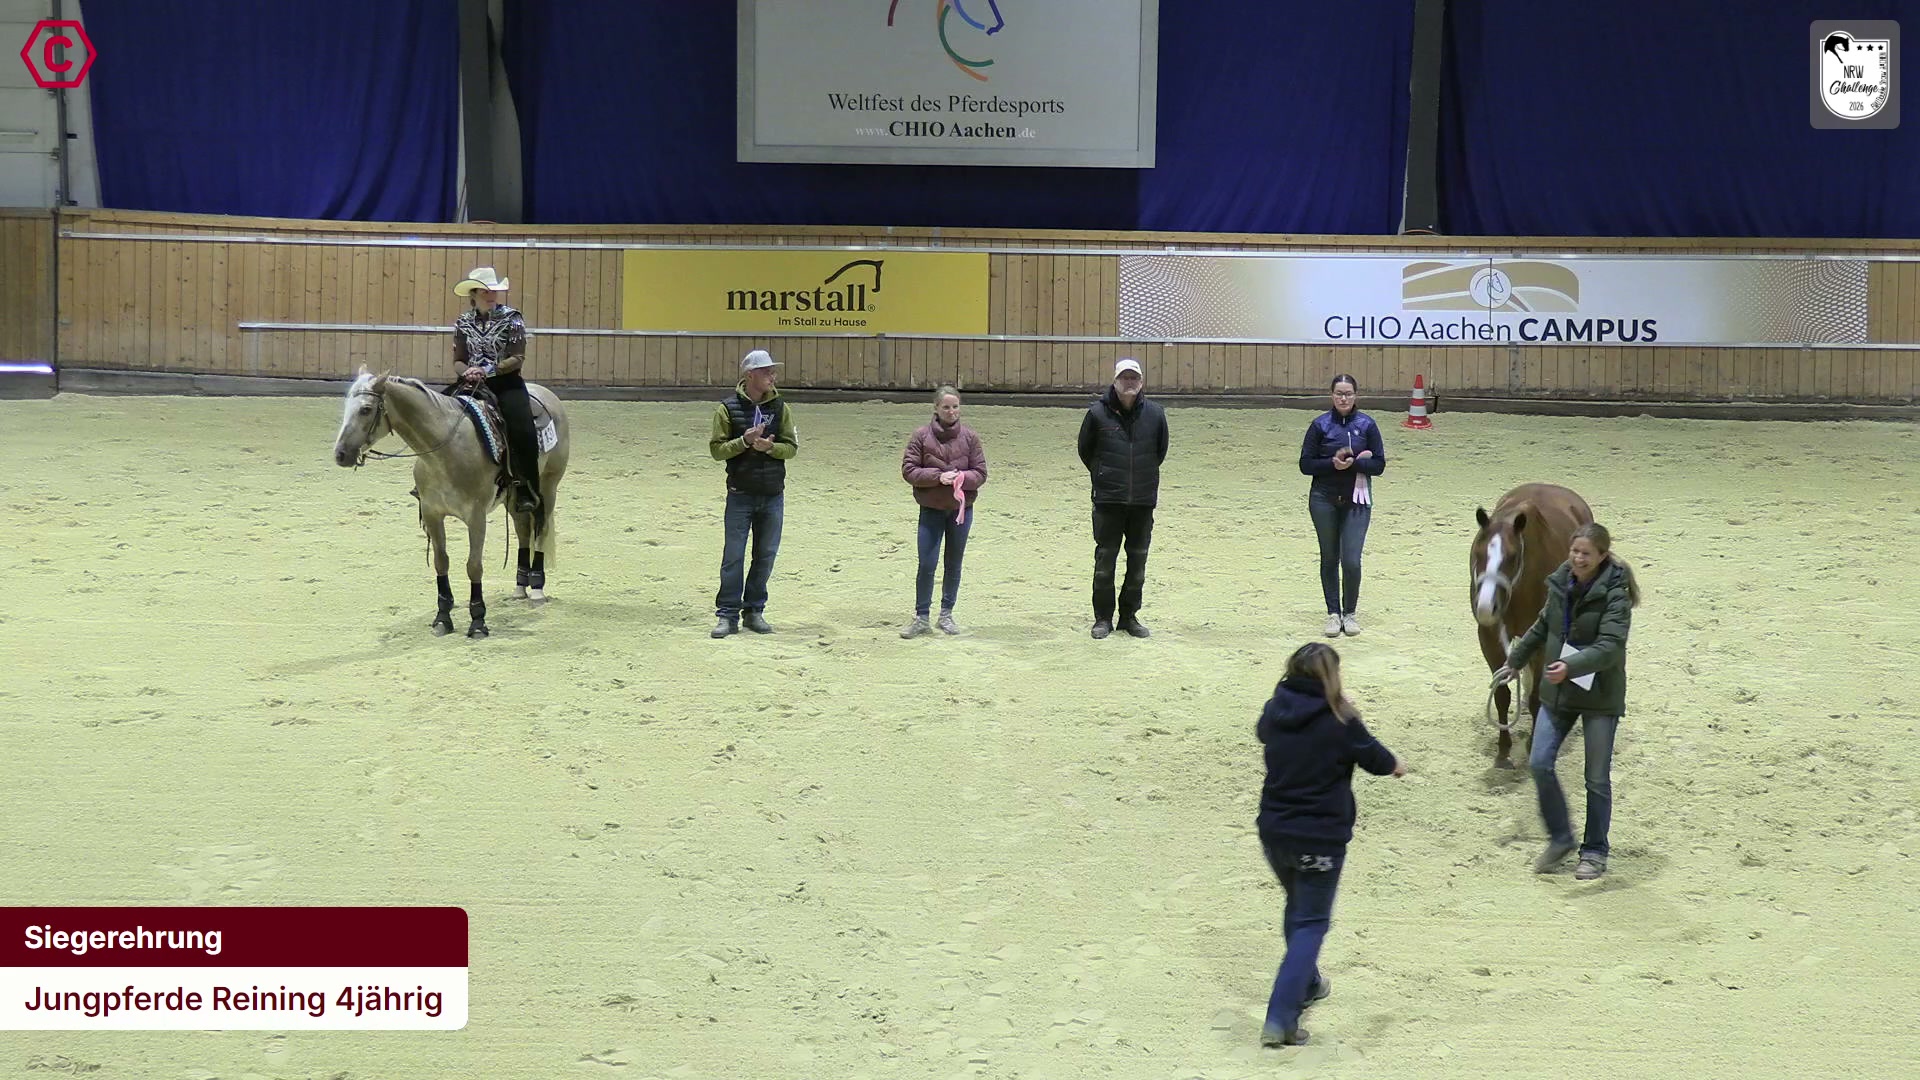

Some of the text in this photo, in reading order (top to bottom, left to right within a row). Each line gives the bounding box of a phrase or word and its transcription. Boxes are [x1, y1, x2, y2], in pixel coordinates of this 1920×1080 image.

[828, 93, 1065, 118] Weltfest des Pferdesports
[778, 317, 867, 327] Im Stall zu Hause
[1324, 315, 1658, 342] CHIO Aachen CAMPUS
